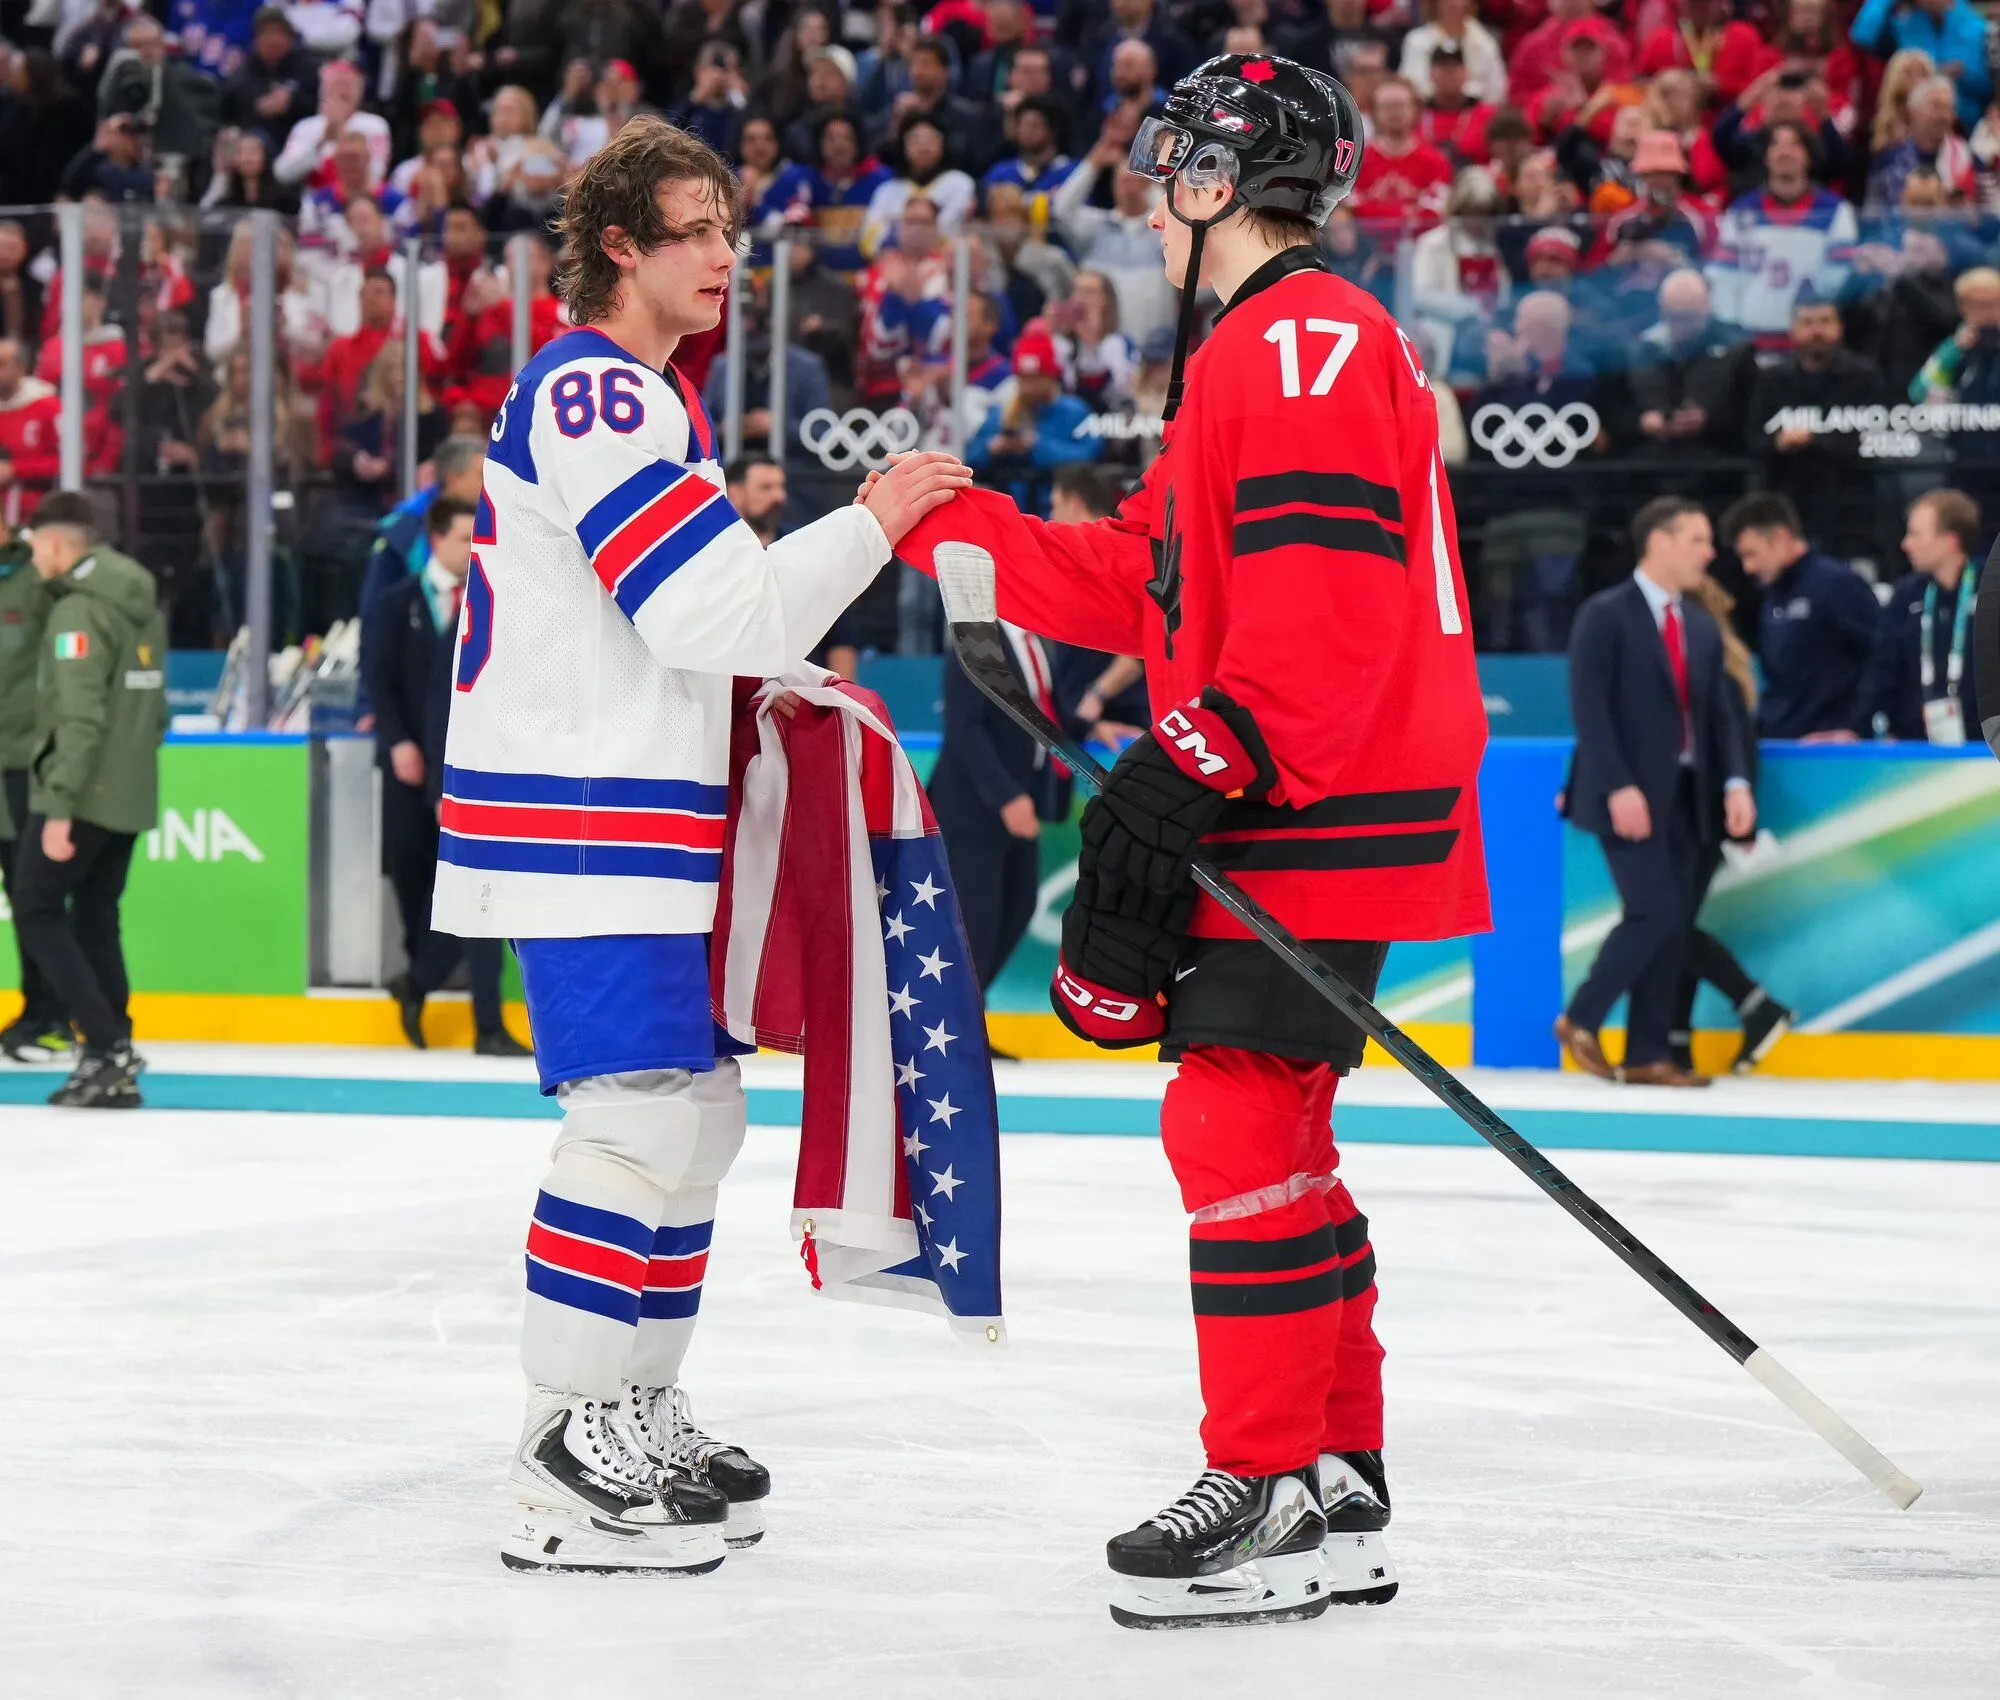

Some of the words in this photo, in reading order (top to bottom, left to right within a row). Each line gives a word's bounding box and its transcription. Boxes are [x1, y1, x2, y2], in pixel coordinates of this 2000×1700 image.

[1335, 138, 1354, 172] 17
[1263, 318, 1359, 398] 17
[1396, 326, 1434, 392] C
[551, 367, 645, 439] 86
[1763, 404, 1888, 434] MILANO
[1056, 964, 1139, 1022] CC
[577, 1469, 632, 1501] BAUER
[1233, 1487, 1306, 1567] CCM
